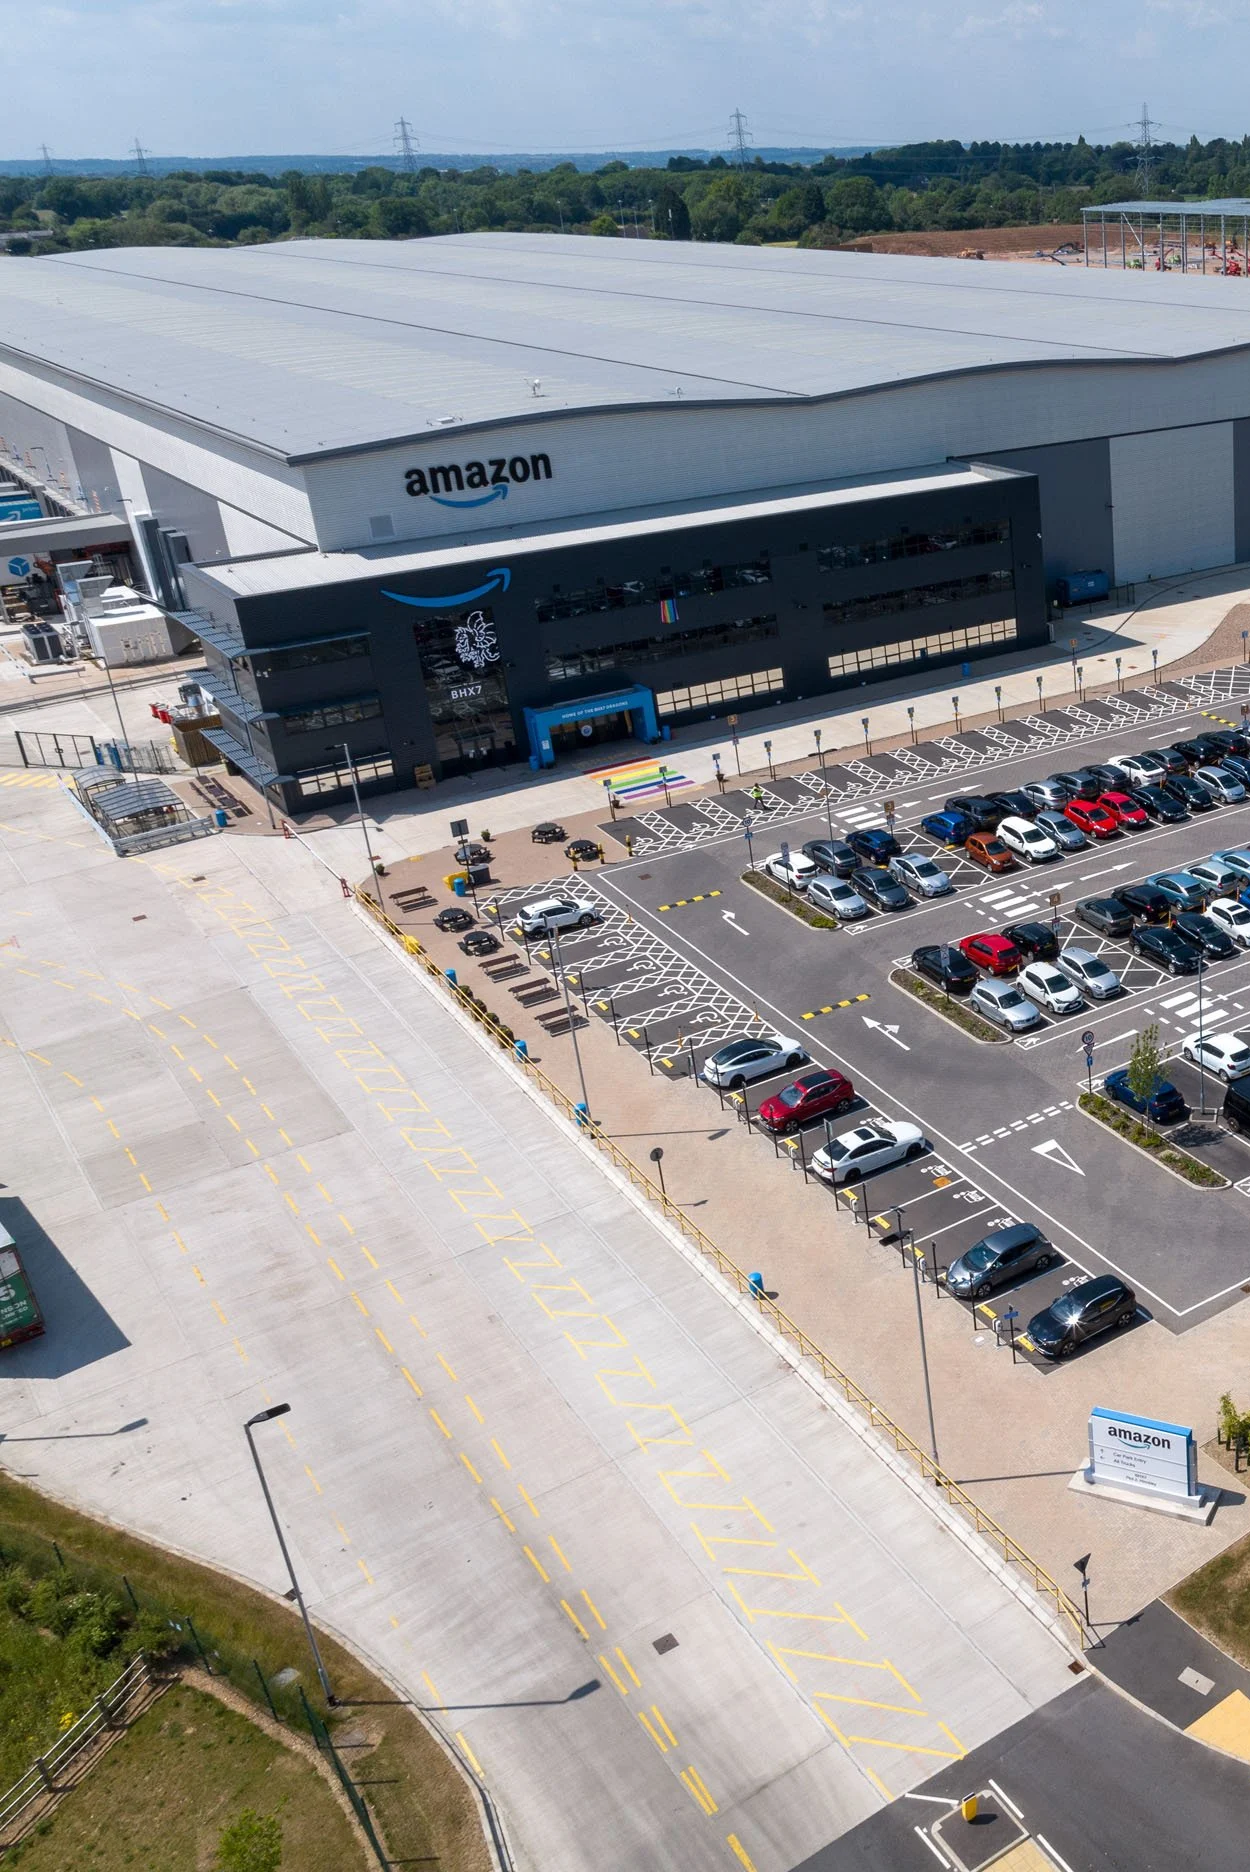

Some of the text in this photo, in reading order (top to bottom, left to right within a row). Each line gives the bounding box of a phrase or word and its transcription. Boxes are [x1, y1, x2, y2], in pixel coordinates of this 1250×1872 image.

[404, 453, 553, 497] amazon
[450, 685, 482, 699] BHX7
[1108, 1426, 1171, 1449] amazon
